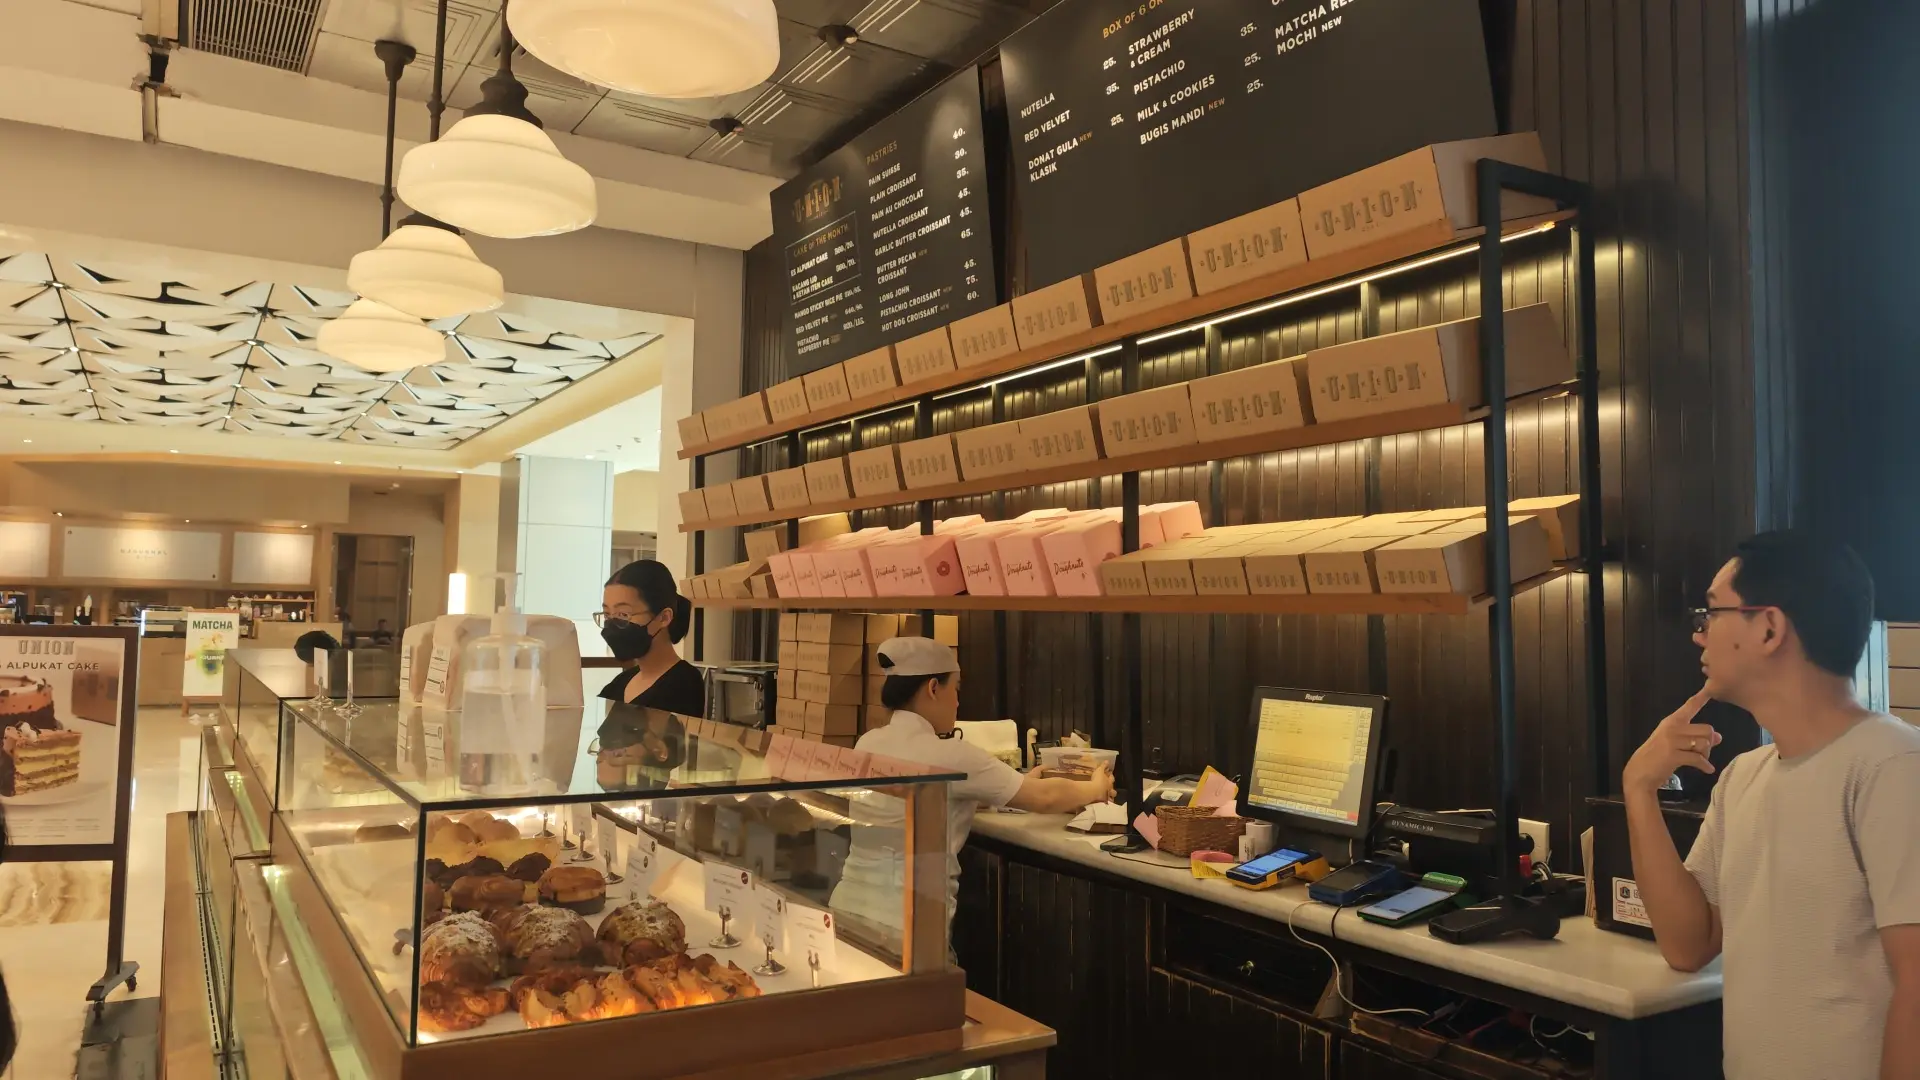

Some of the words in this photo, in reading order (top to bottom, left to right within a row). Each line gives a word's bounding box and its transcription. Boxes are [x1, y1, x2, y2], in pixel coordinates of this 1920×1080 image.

[1103, 18, 1122, 38] BOX
[1125, 11, 1135, 24] OF
[1139, 4, 1146, 15] 6
[1128, 8, 1195, 55] STRAWBERRY
[1275, 4, 1326, 39] MATCHA
[1330, 0, 1354, 11] RE
[1277, 26, 1317, 55] MOCHI
[1322, 16, 1342, 32] NEW
[1130, 60, 1135, 68] &
[1137, 39, 1171, 65] CREAM
[1133, 60, 1185, 95] PISTACHIO
[1240, 22, 1257, 37] 35.
[1137, 104, 1160, 122] MILK
[1162, 100, 1168, 108] &
[1170, 74, 1216, 105] COOKIES
[1244, 53, 1261, 67] 25.
[1021, 92, 1055, 118] NUTELLA
[1140, 124, 1169, 145] BUGIS
[1172, 106, 1205, 130] MANDI
[1208, 97, 1225, 111] NEW
[1246, 78, 1264, 93] 25.
[1024, 128, 1039, 143] RED
[1040, 110, 1070, 133] VELVET
[866, 141, 897, 166] PASTRIES
[868, 173, 880, 187] PAIN
[882, 163, 900, 179] SUISSE
[952, 128, 965, 139] 40.
[1028, 149, 1055, 170] DONAT
[1057, 137, 1079, 155] GULA
[1079, 131, 1093, 142] NEW
[870, 190, 885, 204] PLAIN
[887, 173, 916, 195] CROISSANT
[955, 148, 967, 159] 30.
[1030, 162, 1057, 182] KLASIK
[872, 208, 884, 221] PAIN
[885, 206, 892, 215] AU
[894, 189, 924, 210] CHOCOLAT
[873, 223, 896, 239] NUTELLA
[898, 207, 928, 227] CROISSANT
[958, 188, 971, 199] 45.
[1320, 181, 1416, 237] UNION
[875, 242, 894, 256] GARLIC
[896, 231, 916, 247] BUTTER
[918, 215, 951, 237] CROISSANT
[960, 207, 972, 218] 45.
[794, 244, 807, 257] CAKE
[816, 252, 828, 264] CAKE
[877, 259, 896, 274] BUTTER
[898, 251, 916, 265] PECAN
[961, 229, 973, 238] 65.
[1204, 226, 1284, 273] UNION
[821, 276, 833, 287] CAKE
[878, 266, 907, 284] CROISSANT
[879, 293, 894, 303] LONG
[895, 286, 910, 297] JOHN
[964, 259, 976, 269] 45.
[1110, 265, 1174, 306] UNION
[880, 302, 908, 317] PISTACHIO
[909, 289, 941, 307] CROISSANT
[966, 275, 978, 284] 75.
[882, 322, 892, 332] HOT
[894, 318, 905, 328] DOG
[907, 306, 938, 324] CROISSANT
[967, 291, 979, 301] 60.
[1026, 302, 1078, 336] UNION
[1326, 362, 1421, 402] UNION
[1206, 390, 1282, 425] UNION
[1032, 430, 1084, 458] UNION
[1112, 412, 1178, 442] UNION
[968, 443, 1014, 468] UNION
[1006, 560, 1033, 576] Doughnuts
[1054, 558, 1084, 575] Doughnuts
[1256, 574, 1297, 588] UNION
[1316, 572, 1361, 586] UNION
[1388, 570, 1438, 585] UNION
[192, 621, 233, 629] MATCHA
[19, 640, 74, 655] UNION
[7, 662, 63, 670] ALPUKAT
